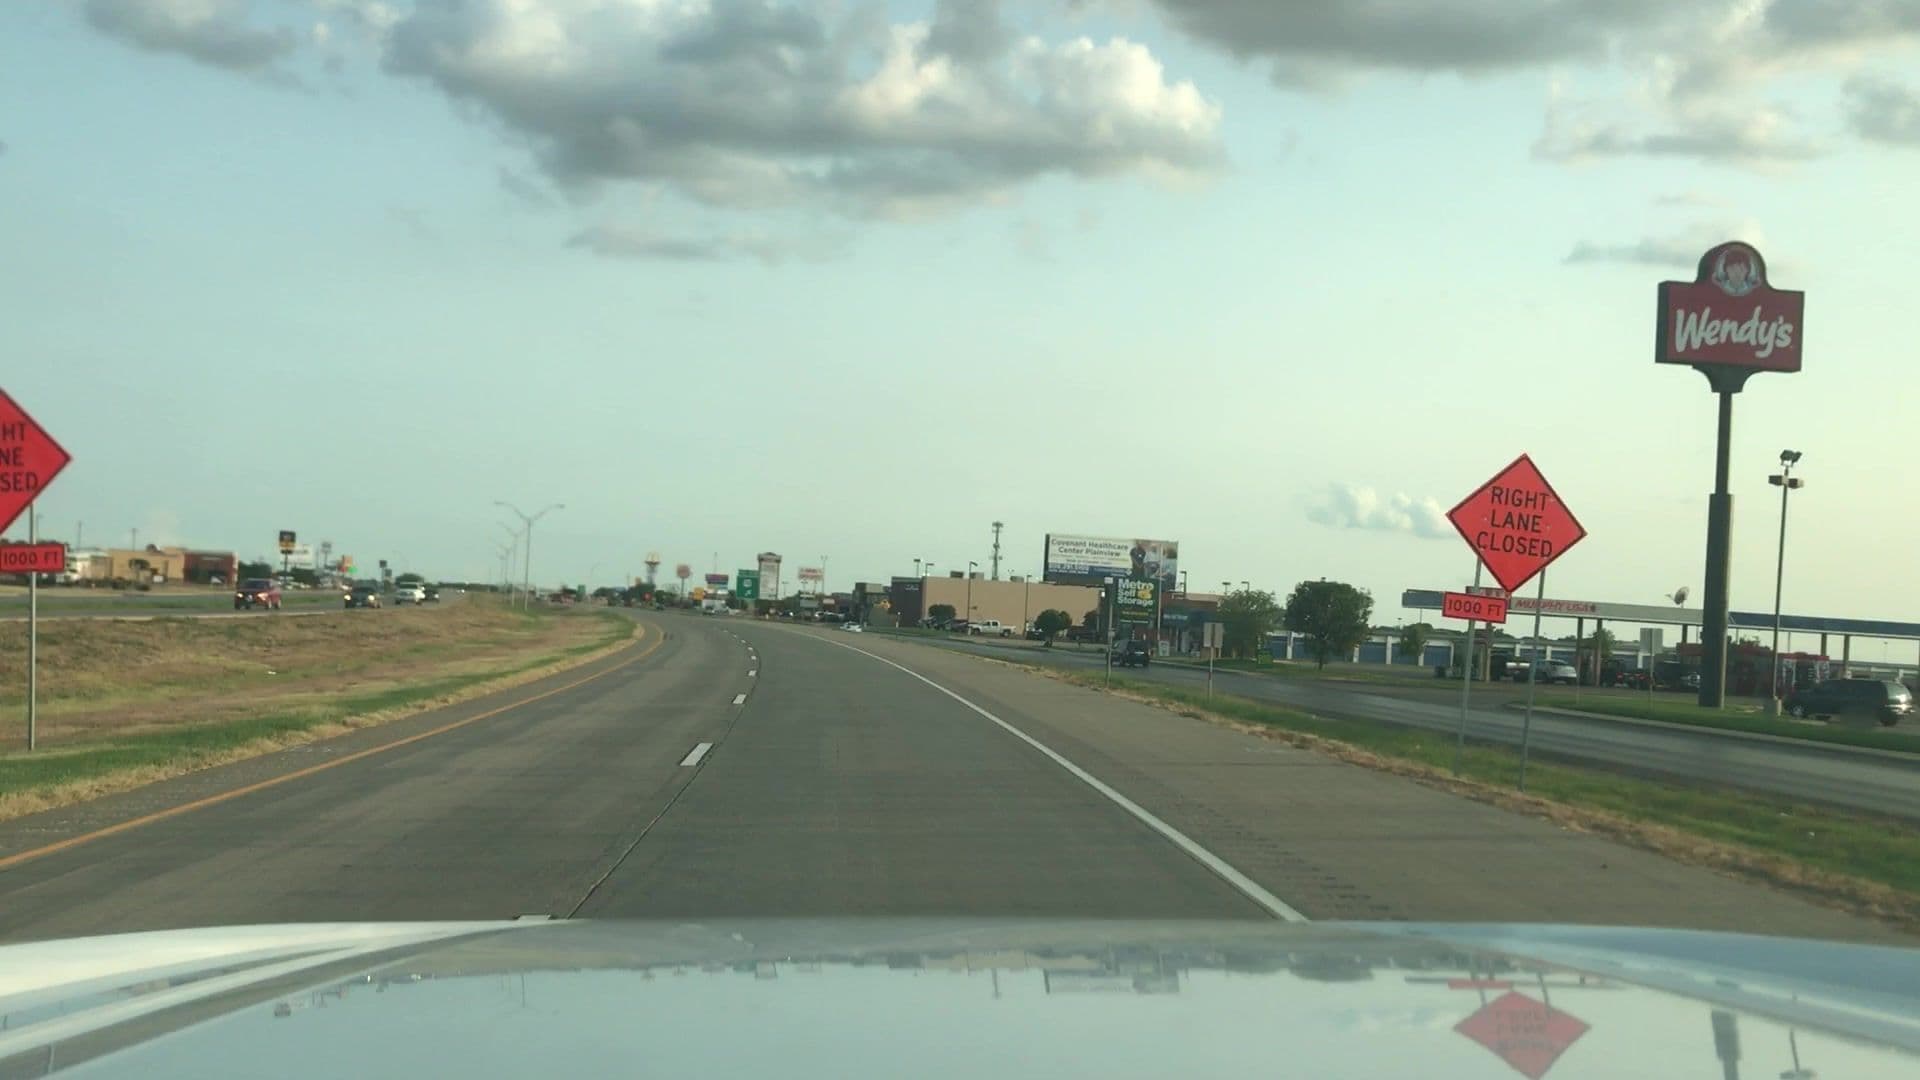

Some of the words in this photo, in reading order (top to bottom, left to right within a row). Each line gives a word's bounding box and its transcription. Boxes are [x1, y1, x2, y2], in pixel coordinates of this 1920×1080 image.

[1675, 306, 1794, 359] Wendy's
[0, 446, 24, 466] NE
[0, 471, 38, 492] SED
[1491, 486, 1550, 511] RIGHT
[1491, 509, 1543, 533] LANE
[1051, 539, 1087, 547] Covenant
[1088, 542, 1129, 550] Healthcare
[1085, 548, 1121, 557] Plainview
[1476, 531, 1553, 558] CLOSED
[2, 551, 37, 565] 1000
[44, 551, 58, 564] FT
[1118, 578, 1154, 590] Metro
[1118, 588, 1136, 597] Self
[1117, 596, 1153, 607] Storage
[1448, 599, 1481, 614] 1000
[1487, 604, 1502, 617] FT
